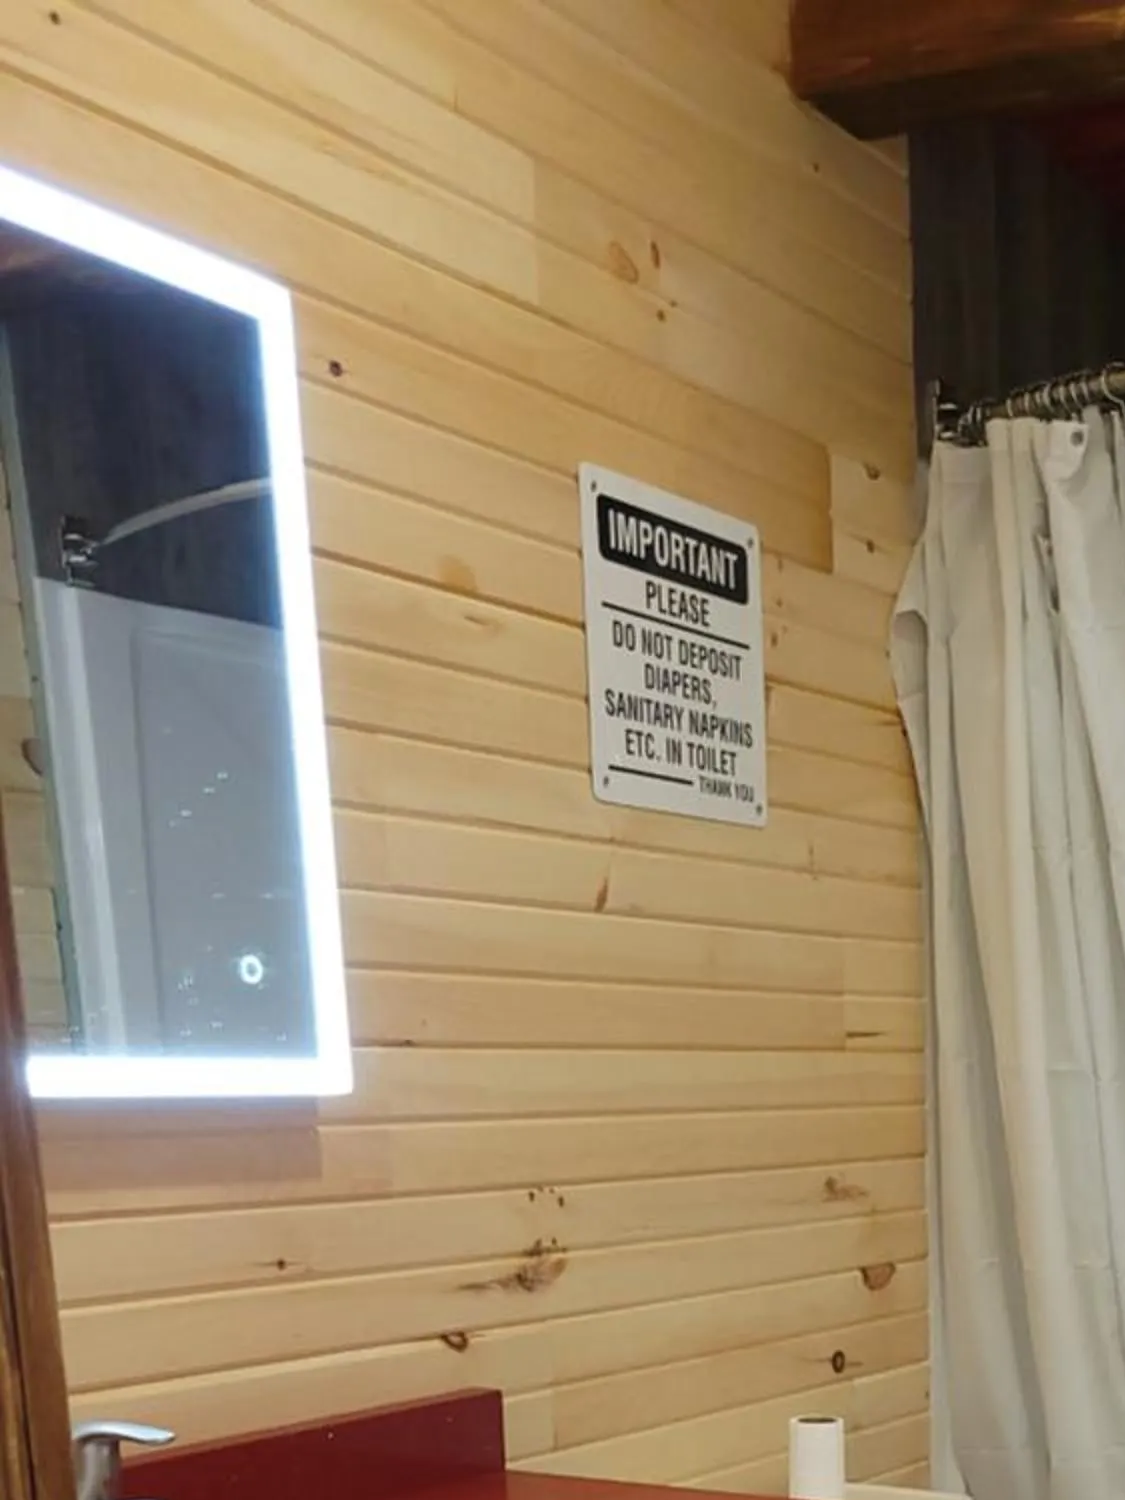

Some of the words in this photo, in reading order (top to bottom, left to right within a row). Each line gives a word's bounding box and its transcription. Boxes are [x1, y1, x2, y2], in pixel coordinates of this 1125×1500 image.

[607, 507, 738, 590] IMPORTANT
[645, 580, 710, 627] PLEASE
[612, 619, 636, 650] DO
[641, 629, 672, 660] NOT
[678, 642, 742, 680] DEPOSIT
[644, 663, 717, 708] DIAPERS,
[605, 688, 684, 729] SANITARY
[688, 711, 753, 748] NAPKINS
[624, 728, 660, 762] ETC.
[665, 737, 683, 767] IN
[687, 742, 736, 777] TOILET
[699, 775, 732, 799] THANK
[733, 783, 755, 803] YOU
